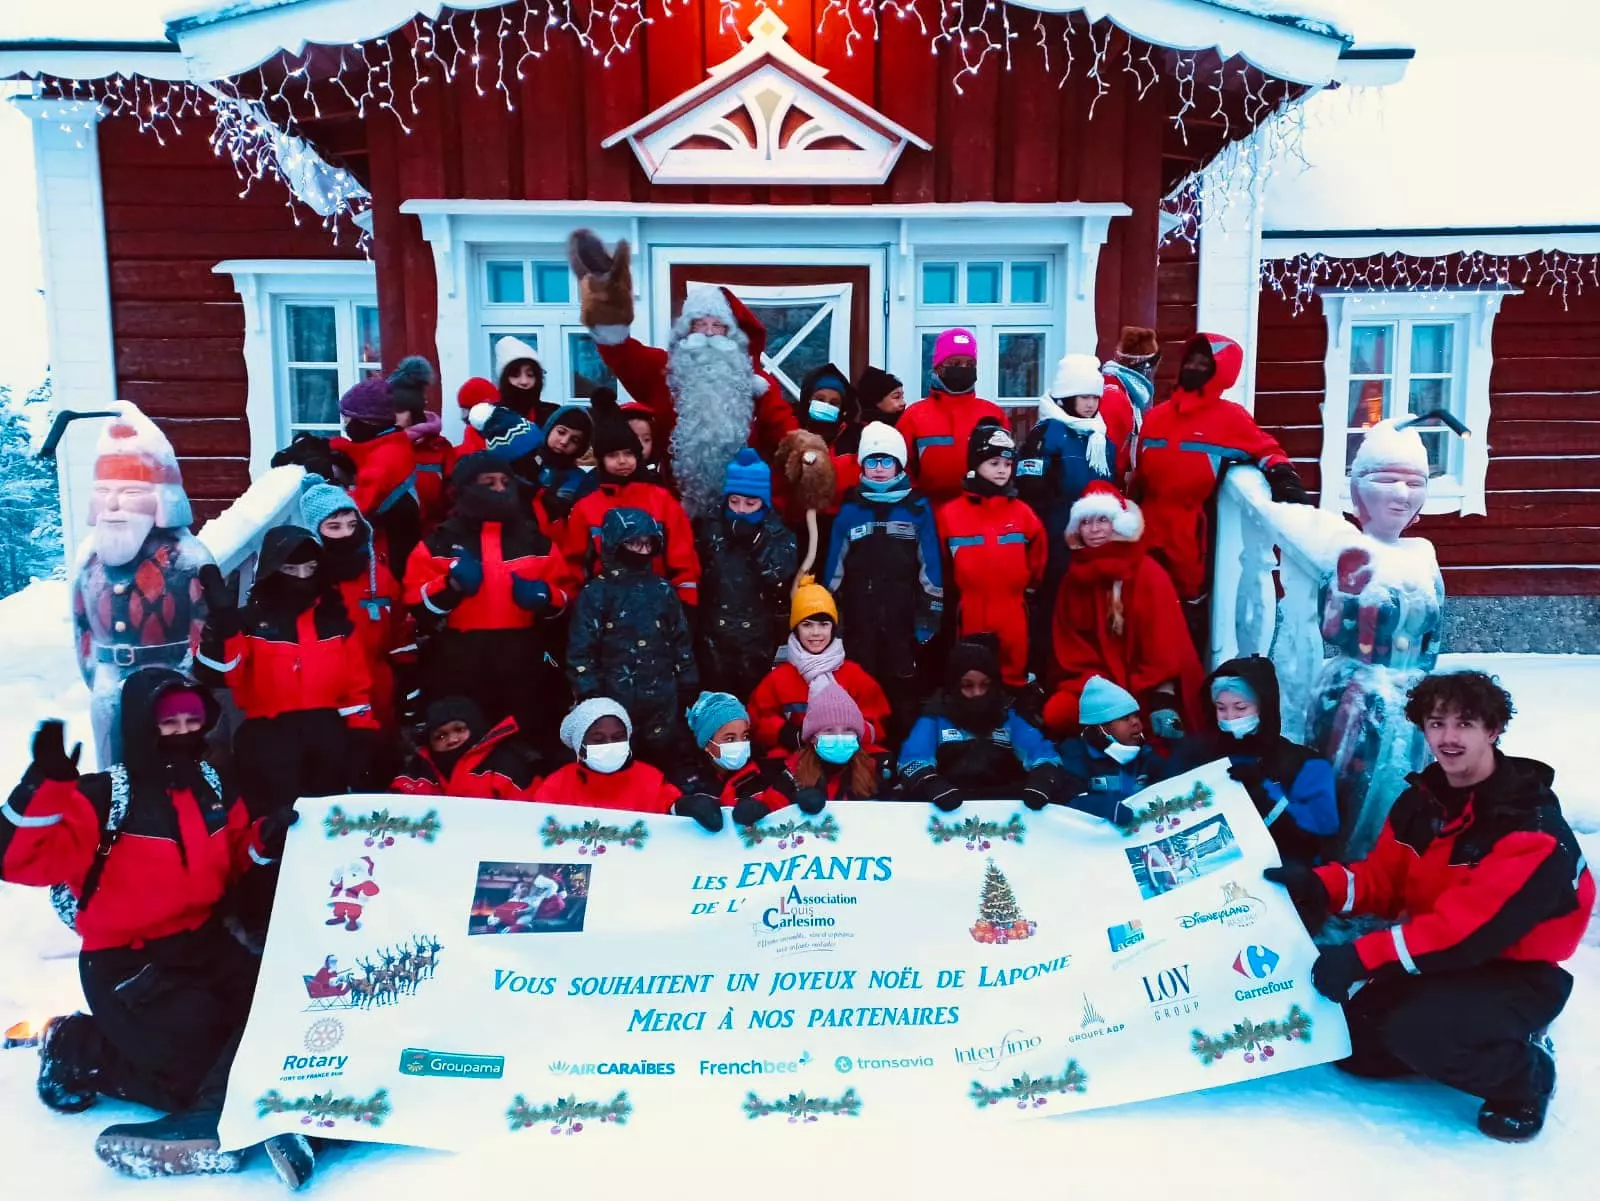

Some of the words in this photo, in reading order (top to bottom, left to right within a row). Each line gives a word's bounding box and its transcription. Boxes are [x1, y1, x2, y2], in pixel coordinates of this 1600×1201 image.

[690, 875, 728, 890] LES
[735, 854, 893, 889] ENFANTS
[786, 884, 857, 905] Association
[690, 902, 720, 915] DE
[780, 896, 815, 915] Louis
[762, 907, 836, 929] Carlesimo
[567, 974, 715, 996] SOUHAITENT
[726, 972, 760, 992] UN
[768, 971, 857, 997] JOYEUX
[867, 966, 923, 990] NOËL
[936, 969, 966, 989] DE
[978, 954, 1073, 988] LAPONIE
[1143, 964, 1191, 1003] LOV
[1234, 979, 1295, 1002] Carrefour
[626, 1008, 707, 1032] MERCI
[717, 1006, 735, 1030] À
[747, 1009, 796, 1029] NOS
[806, 1006, 960, 1028] PARTENAIRES
[1153, 1001, 1201, 1021] GROUP
[1068, 1028, 1105, 1043] GROUPE
[1106, 1023, 1125, 1034] ADP
[283, 1054, 348, 1071] Rotary
[430, 1058, 501, 1074] Groupama
[857, 1055, 934, 1069] transavia
